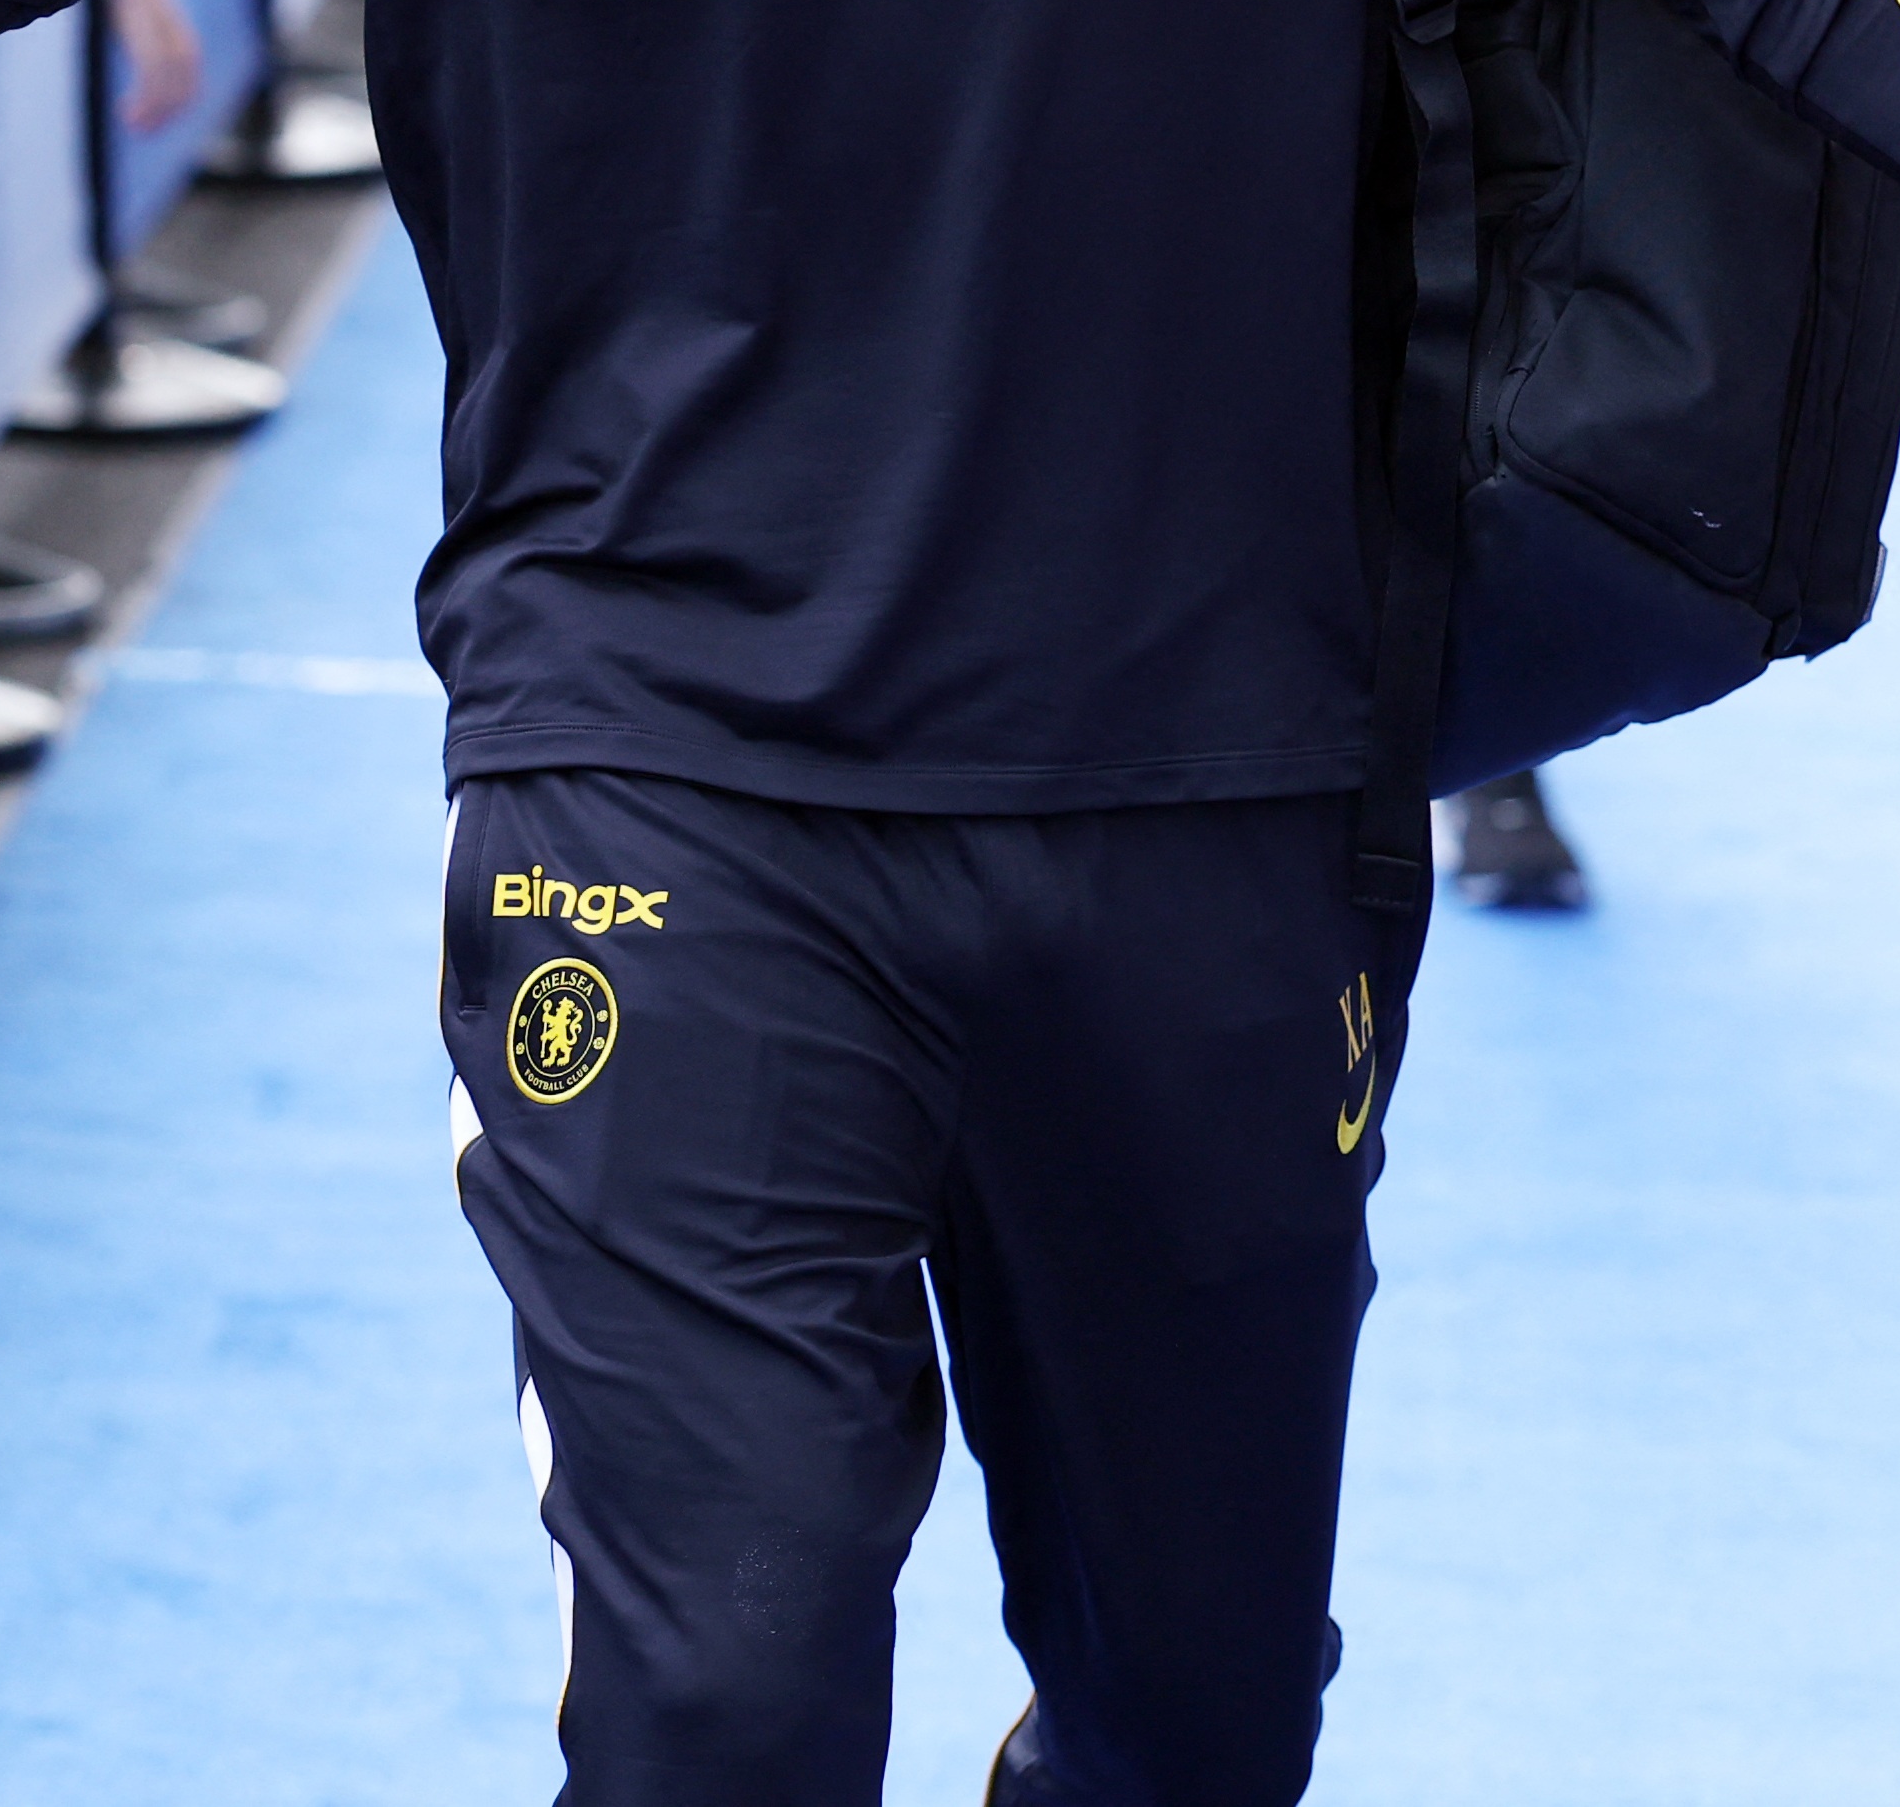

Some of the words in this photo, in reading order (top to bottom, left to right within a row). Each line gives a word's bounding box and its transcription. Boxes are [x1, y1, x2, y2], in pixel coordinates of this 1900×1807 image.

[532, 971, 595, 1000] CHELSEA
[524, 1068, 564, 1091] FOOTBALL
[566, 1063, 589, 1085] CLUB
